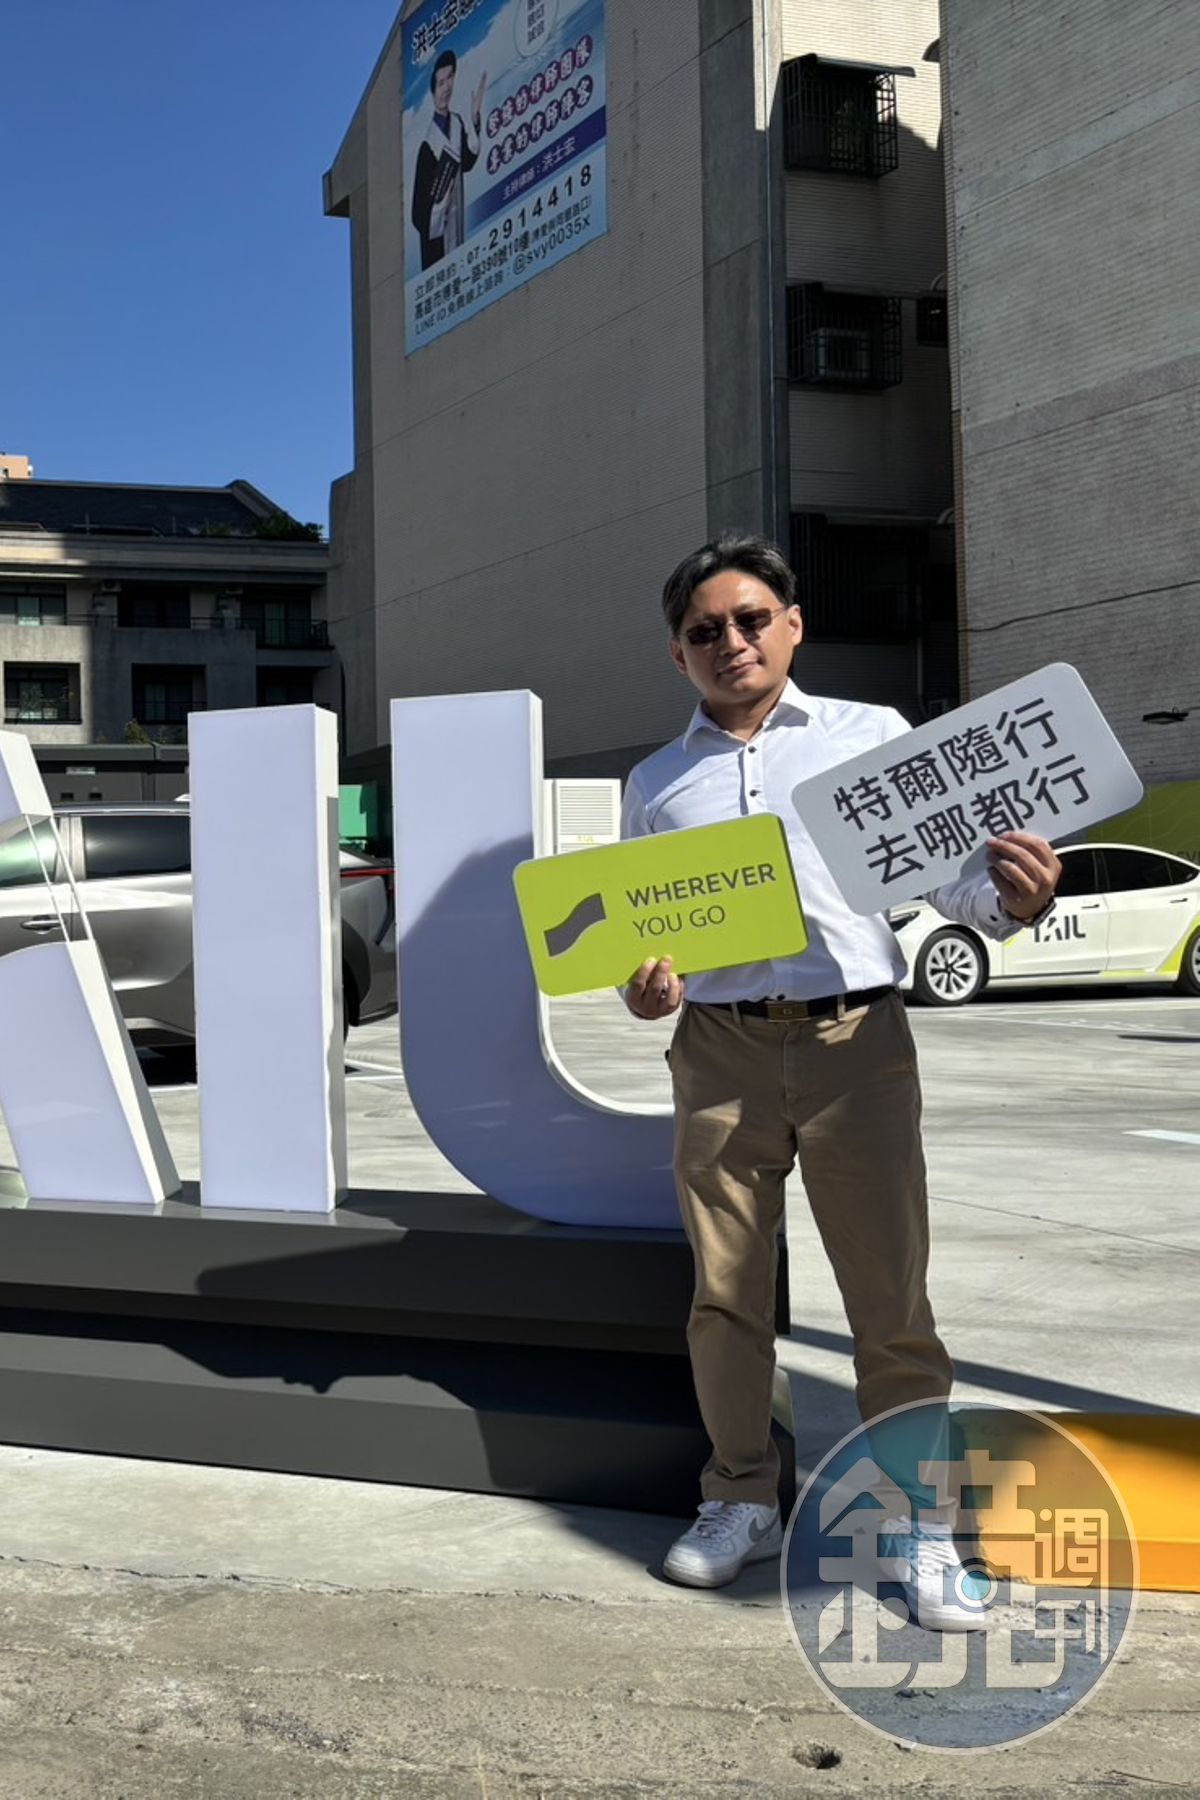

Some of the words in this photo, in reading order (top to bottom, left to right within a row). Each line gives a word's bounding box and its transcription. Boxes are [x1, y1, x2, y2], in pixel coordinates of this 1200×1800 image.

[833, 697, 1059, 831] 特爾隨行
[865, 753, 1090, 885] 去哪都行
[626, 863, 777, 908] WHEREVER
[633, 913, 683, 938] YOU
[689, 905, 726, 928] GO
